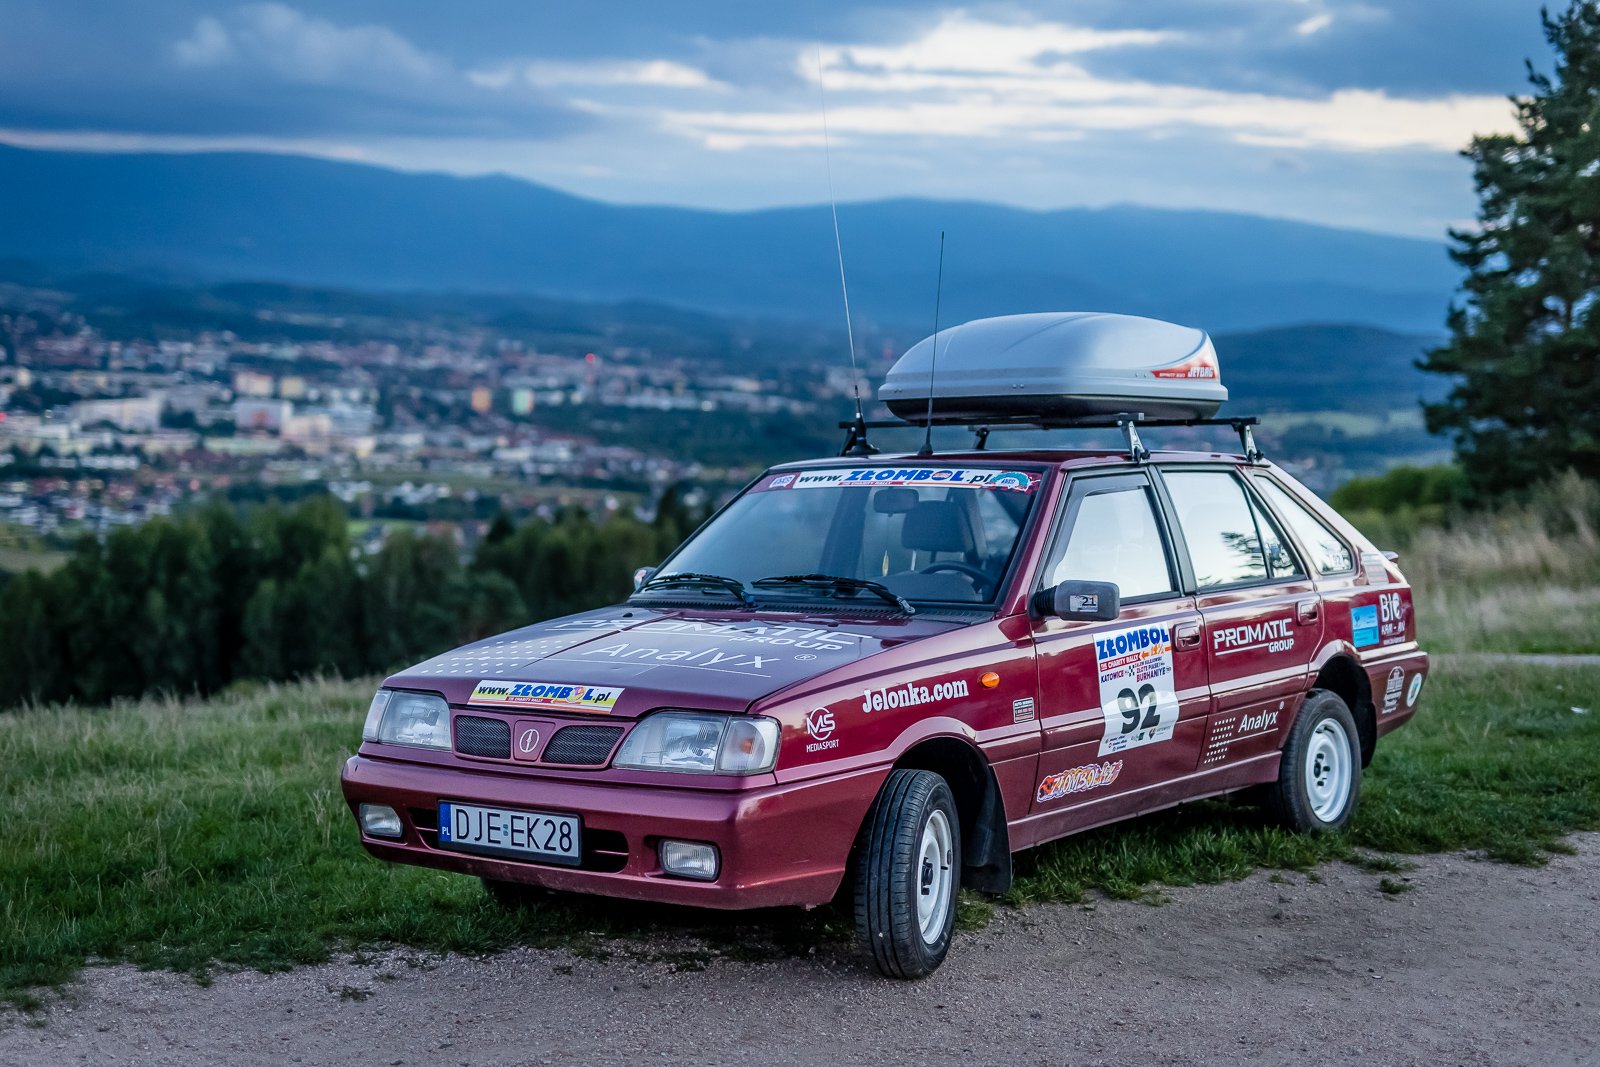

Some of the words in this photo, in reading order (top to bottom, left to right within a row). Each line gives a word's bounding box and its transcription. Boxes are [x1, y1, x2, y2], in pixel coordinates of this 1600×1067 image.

[1188, 367, 1213, 378] JETBAG
[1082, 596, 1097, 607] 21
[555, 618, 873, 646] PROMATIC
[728, 635, 843, 652] GROUP
[1096, 627, 1170, 661] ZŁOMBOL
[1213, 618, 1294, 650] PROMATIC
[582, 643, 780, 669] Analyx
[1269, 638, 1294, 653] GROUP
[1100, 669, 1124, 684] KATOWICE
[862, 679, 970, 713] Jelonka.com
[1117, 683, 1161, 735] 92
[1237, 709, 1279, 733] Analyx
[805, 739, 840, 753] MEDIASPORT
[441, 826, 451, 836] PL
[455, 808, 502, 845] DJE
[510, 814, 573, 853] EK28
